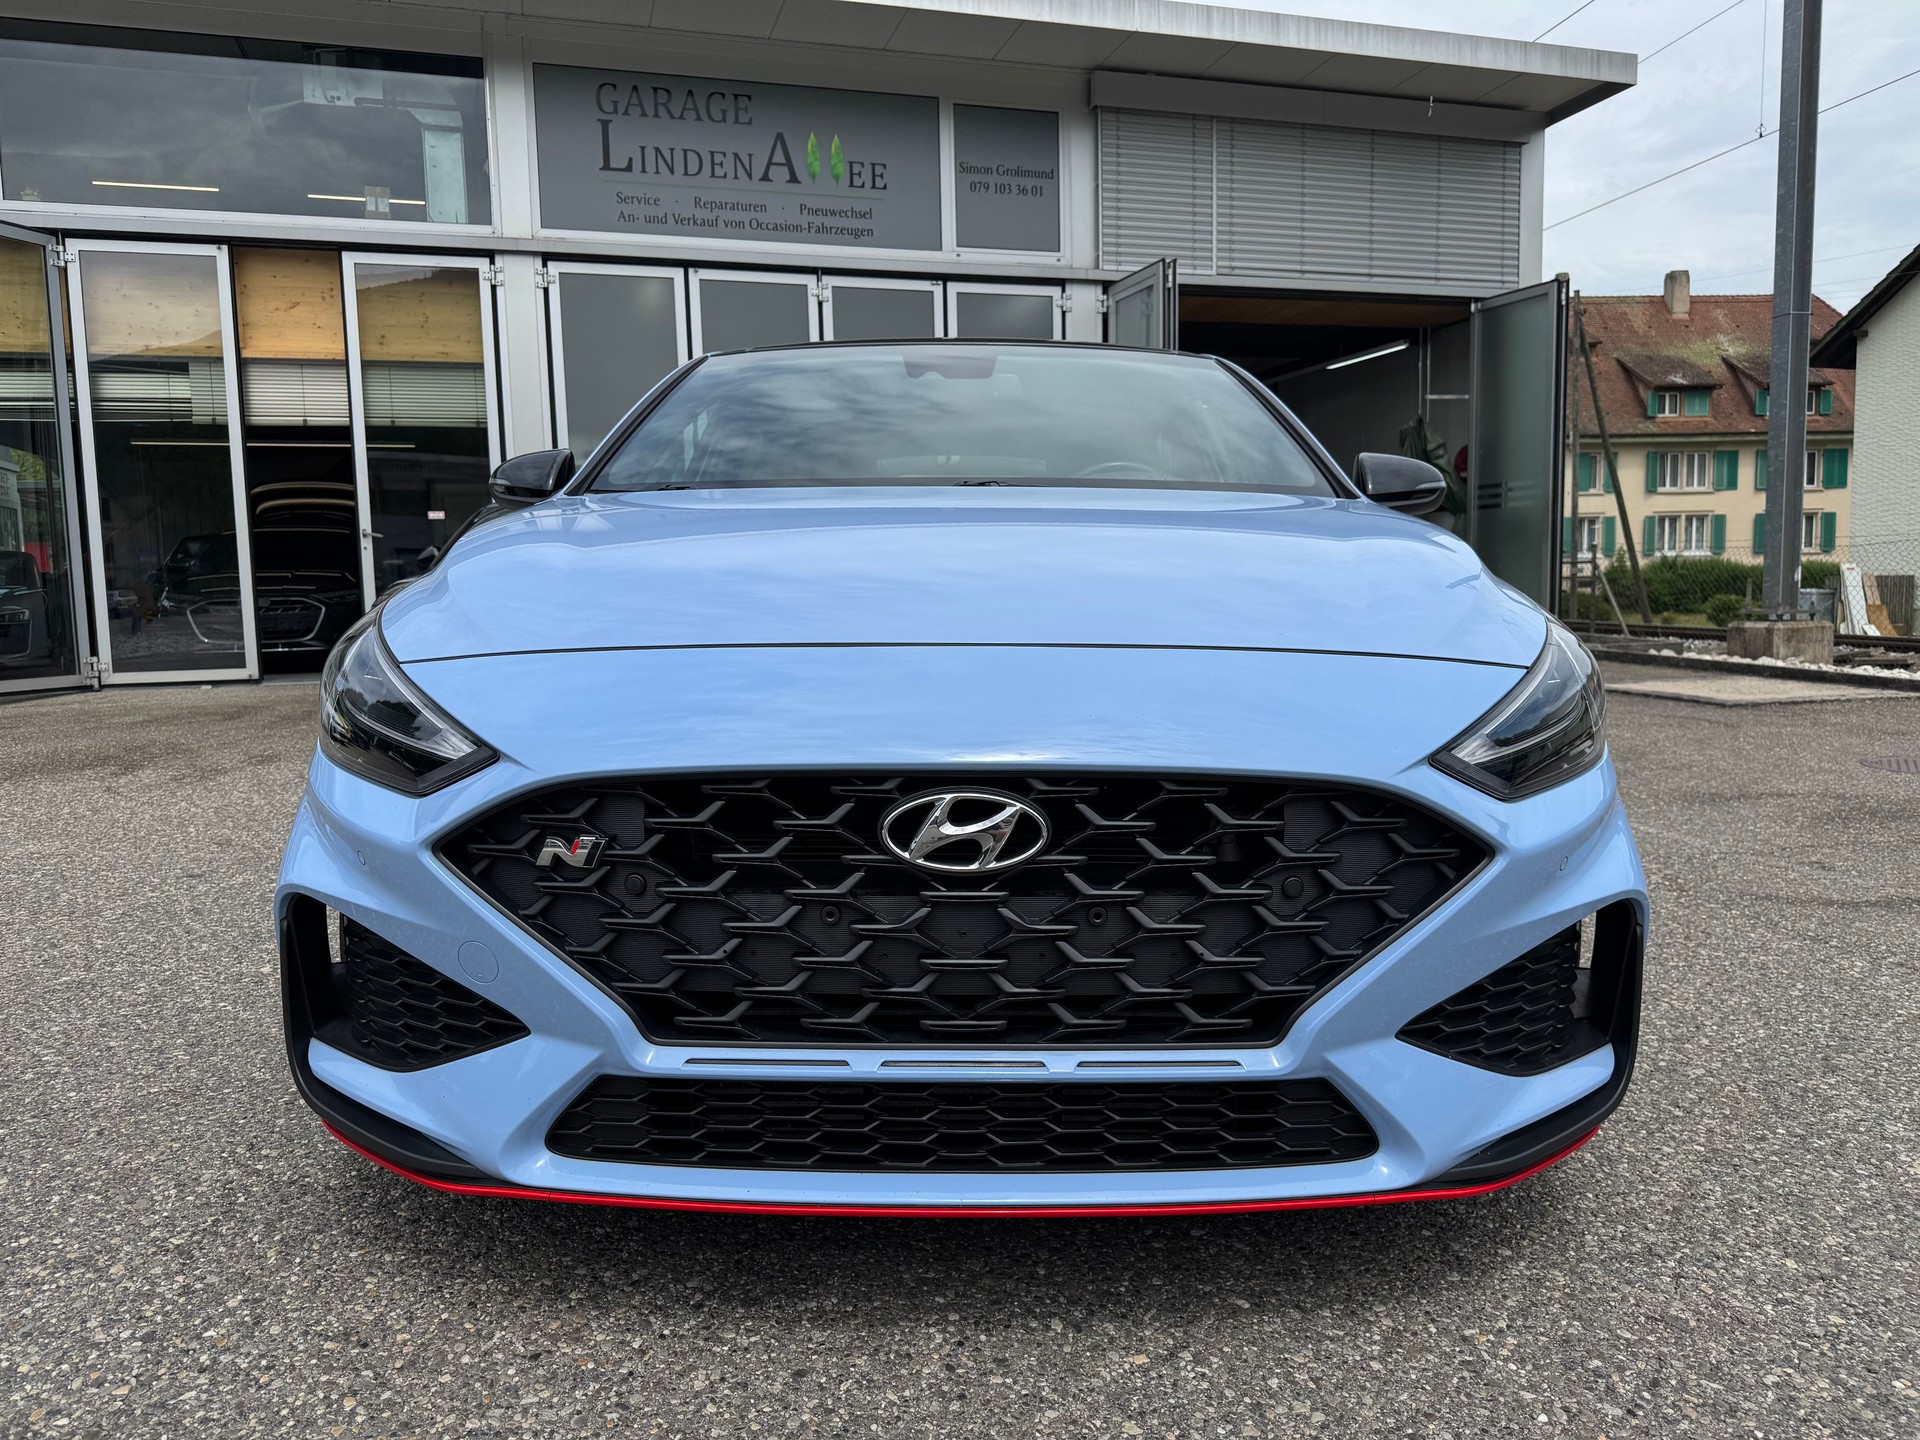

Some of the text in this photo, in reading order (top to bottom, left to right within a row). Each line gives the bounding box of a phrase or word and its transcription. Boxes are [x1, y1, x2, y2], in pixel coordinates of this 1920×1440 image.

[596, 82, 753, 125] GARAGE
[958, 161, 1054, 180] Simon Grolimund
[969, 181, 990, 193] 079
[994, 182, 1012, 195] 103
[616, 191, 873, 220] Service Reparaturen Pneuwechsel
[617, 210, 874, 240] An- und Verkauf von Occasion-Fahrzeugen
